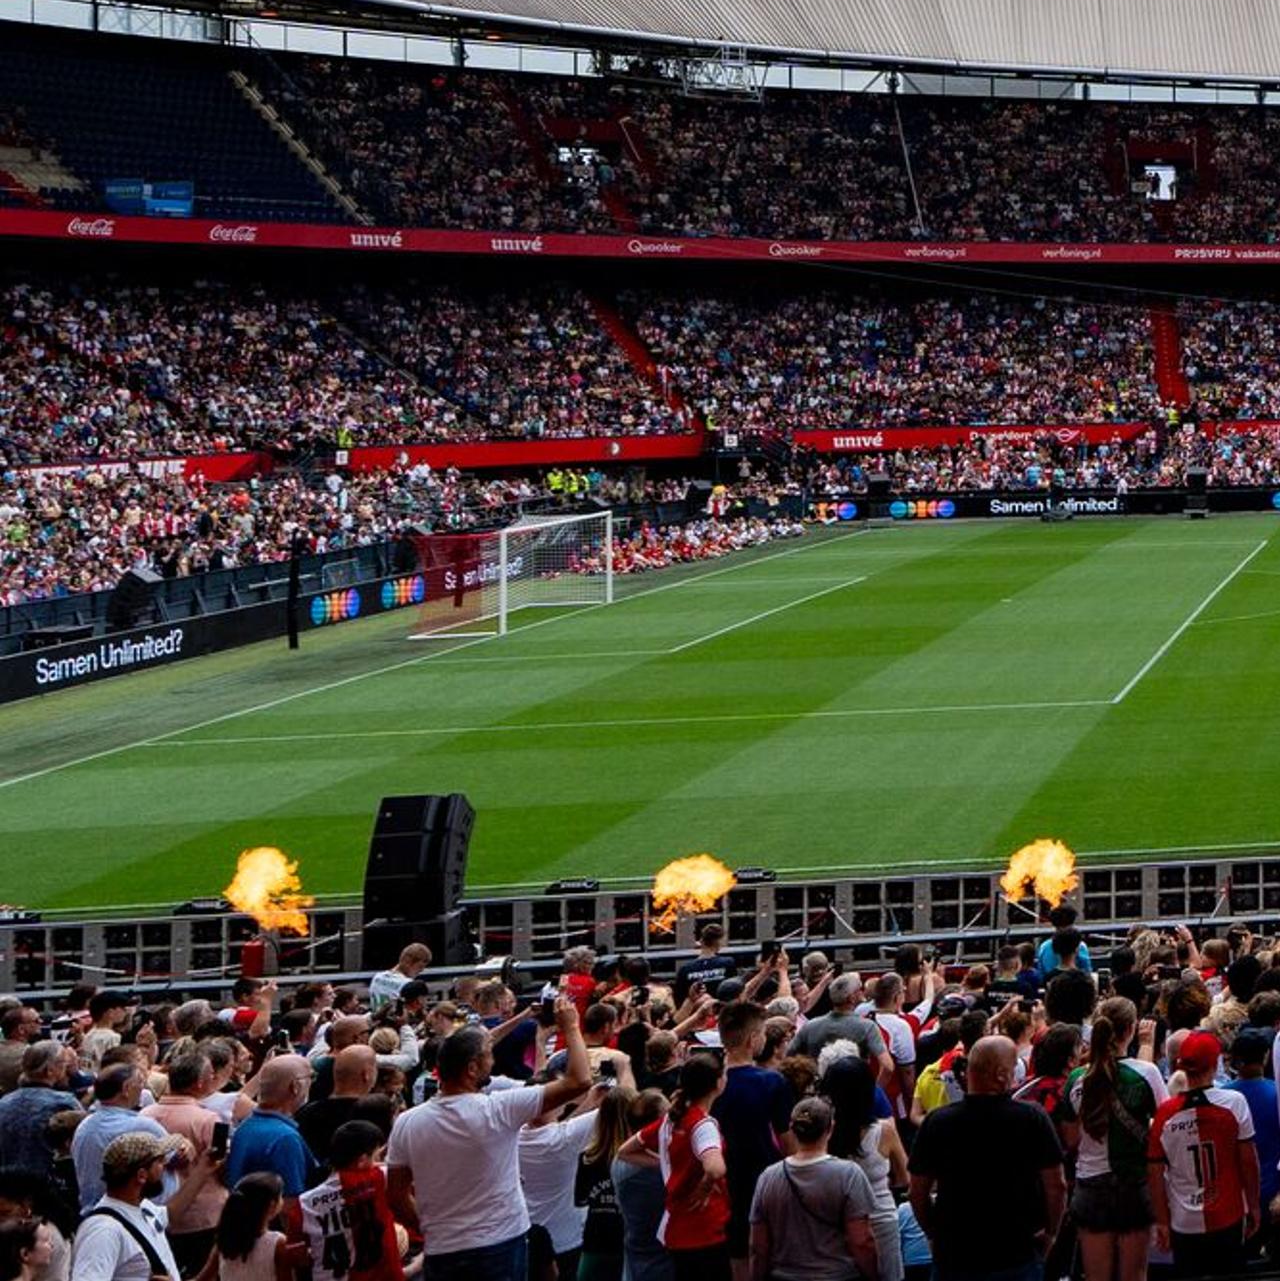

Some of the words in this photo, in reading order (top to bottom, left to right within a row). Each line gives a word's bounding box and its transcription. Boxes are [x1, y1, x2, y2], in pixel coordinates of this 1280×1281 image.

[351, 232, 403, 248] univé
[491, 238, 544, 254] univé
[628, 239, 683, 254] Quooker
[769, 242, 823, 257] Quooker
[833, 431, 884, 448] univé
[990, 499, 1043, 513] Samen
[35, 652, 98, 684] Samen
[100, 629, 184, 668] Unlimited?
[1187, 1142, 1216, 1187] 11
